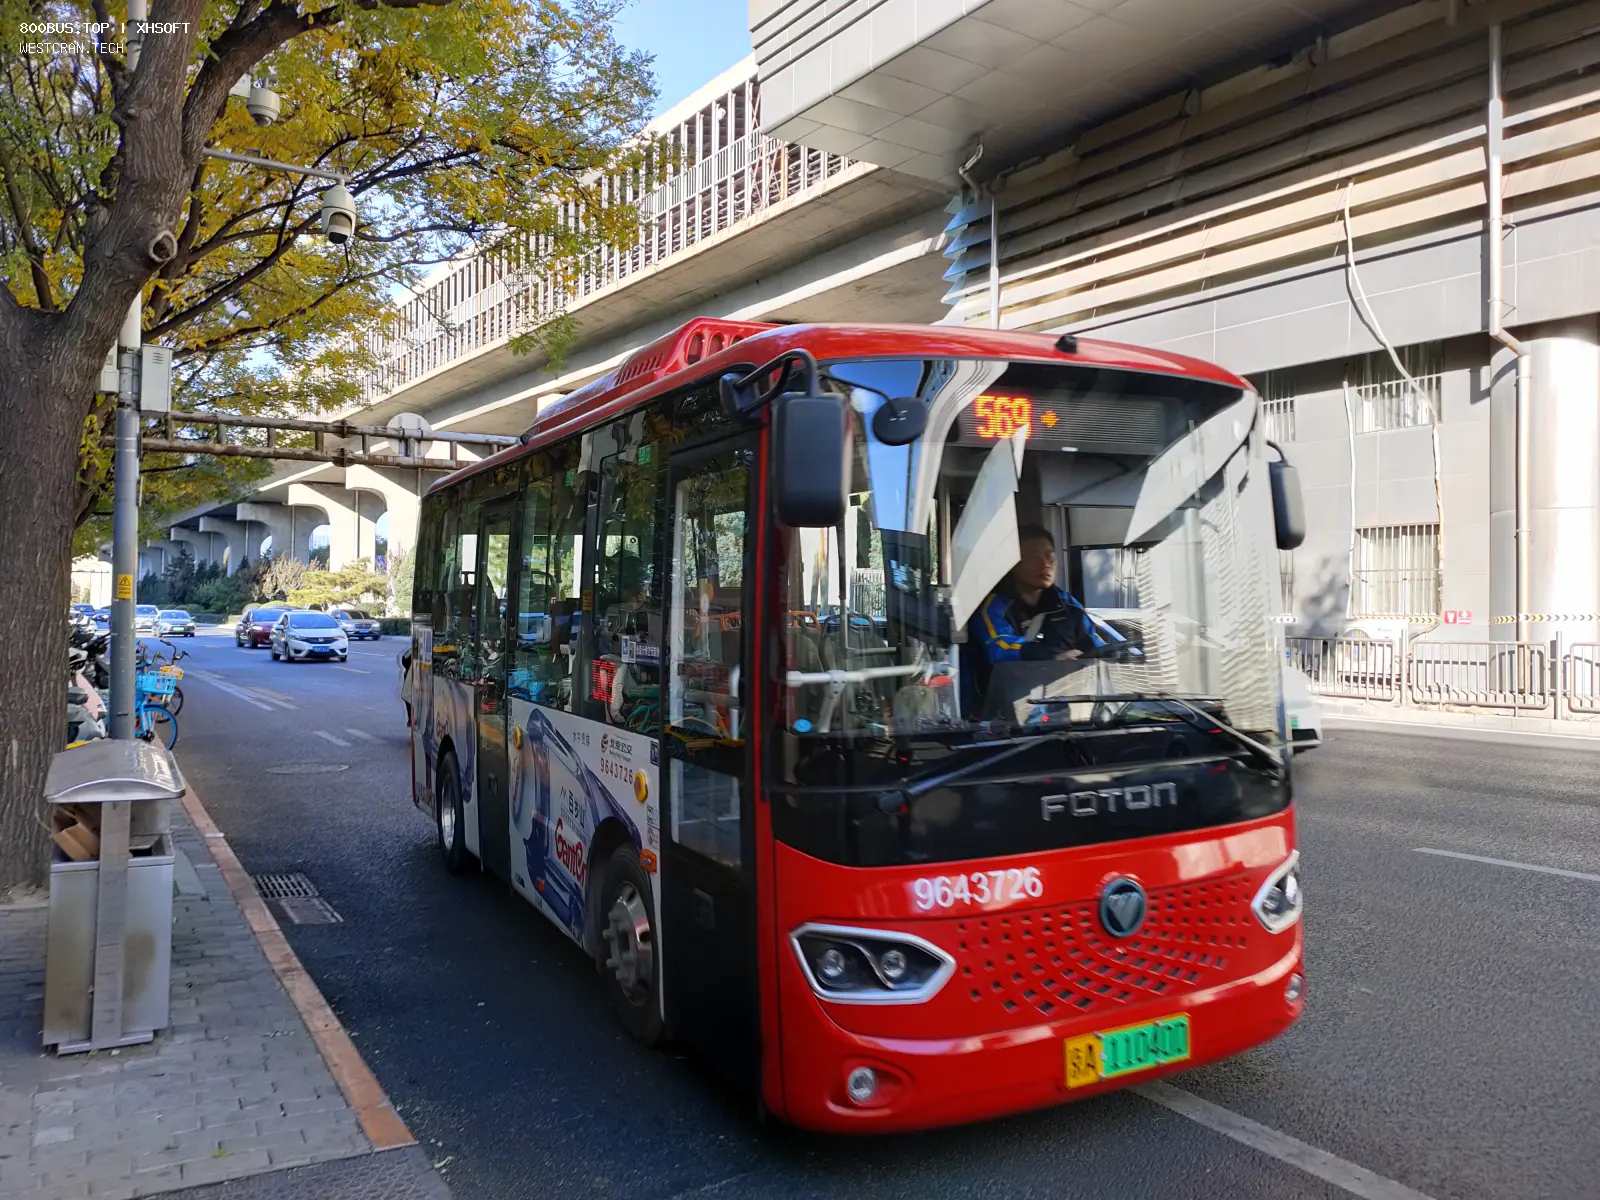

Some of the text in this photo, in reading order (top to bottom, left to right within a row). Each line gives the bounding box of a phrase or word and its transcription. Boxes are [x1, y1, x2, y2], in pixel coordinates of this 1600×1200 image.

[975, 395, 1032, 440] 569
[600, 758, 634, 785] 9643726
[914, 866, 1043, 910] 9643726
